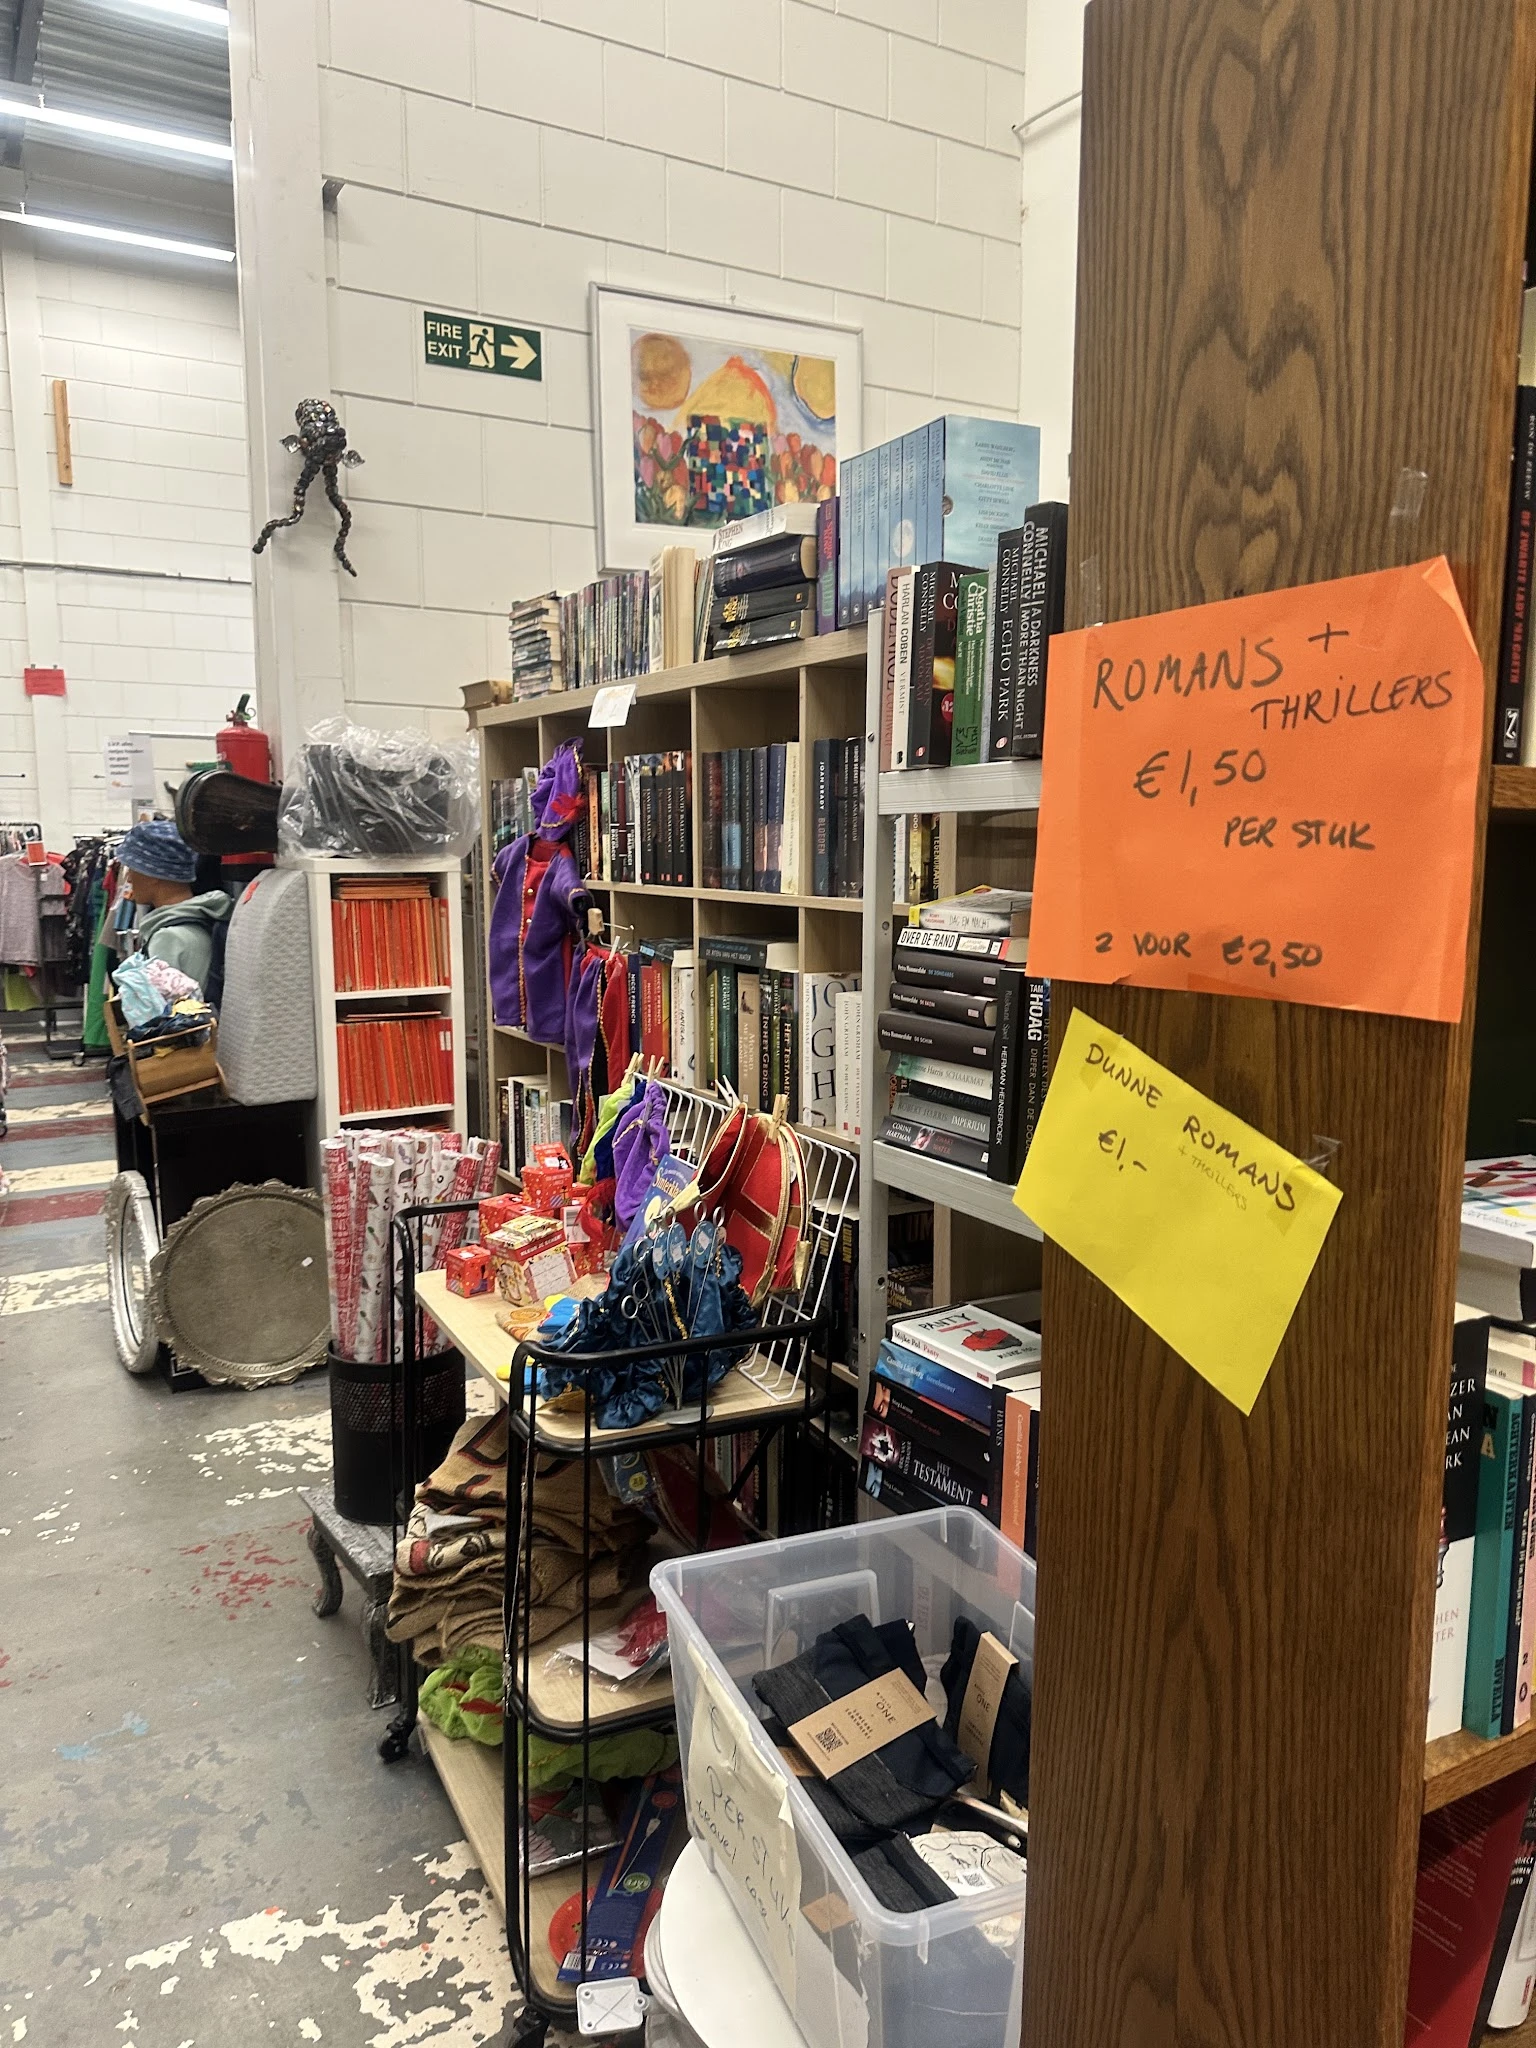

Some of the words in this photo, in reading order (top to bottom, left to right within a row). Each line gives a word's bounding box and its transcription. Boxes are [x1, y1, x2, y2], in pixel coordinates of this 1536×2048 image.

[426, 321, 463, 340] FIRE
[427, 341, 463, 359] EXIT
[1528, 413, 1536, 437] RON
[1527, 442, 1535, 457] DE
[1523, 460, 1533, 500] ZEEUW
[718, 523, 743, 540] STEPHEN
[1011, 547, 1019, 604] MICHAEL
[1019, 520, 1034, 599] CONNELLY
[1032, 527, 1048, 600] MICHAEL
[927, 571, 936, 624] MICHAEL
[1000, 549, 1011, 614] CONNELLY
[900, 583, 911, 625] HARLAN
[919, 572, 929, 633] CONNELLY
[964, 581, 978, 637] Christie
[975, 585, 987, 634] Agatha
[1514, 586, 1525, 618] LADY
[899, 628, 910, 664] COBEN
[1001, 619, 1013, 672] ECHO
[1018, 609, 1029, 647] MORE
[1017, 649, 1028, 686] THAN
[1027, 620, 1041, 686] DARKNESS
[1092, 636, 1284, 712] ROMANS
[1308, 622, 1349, 653] +
[897, 671, 906, 716] VERMIST
[997, 678, 1011, 721] PARK
[1014, 687, 1025, 730] NIGHT
[1133, 749, 1267, 807] €1,50
[817, 817, 826, 855] BLOEDEN
[1223, 816, 1274, 849] PER
[1296, 820, 1376, 851] STUK
[900, 930, 920, 945] OVER
[920, 932, 933, 947] DE
[934, 934, 956, 948] RAND
[1095, 932, 1113, 954] 2
[1132, 932, 1191, 959] VOOR
[1221, 935, 1324, 978] €2,50
[762, 1014, 770, 1029] IN
[783, 1022, 792, 1046] HET
[1001, 1023, 1011, 1040] Spel
[1027, 994, 1044, 1042] HOAG
[1043, 1017, 1050, 1030] DE
[748, 1033, 756, 1070] MOORD
[762, 1030, 770, 1051] HET
[1041, 1031, 1049, 1079] ENGELEN
[762, 1053, 770, 1097] GEDING
[927, 1065, 944, 1077] Harris
[945, 1069, 985, 1087] SCHAAKMAT
[999, 1045, 1008, 1086] HERMAN
[1029, 1047, 1039, 1079] DIEPER
[926, 1087, 955, 1100] PAULA
[1027, 1082, 1036, 1104] DAN
[891, 1121, 913, 1134] CORINE
[897, 1102, 921, 1116] ROBERT
[951, 1115, 987, 1133] IMPERIUM
[995, 1086, 1006, 1145] HEINSBROEK
[1026, 1107, 1035, 1121] DE
[1084, 1042, 1164, 1109] DUNNE
[1182, 1114, 1297, 1212] ROMANS
[885, 1129, 912, 1143] HARTMAN
[917, 1312, 973, 1331] PANTY
[894, 1329, 911, 1345] Mijke
[911, 1337, 921, 1349] Pol
[922, 1344, 941, 1360] Panty
[886, 1355, 904, 1369] Camilla
[902, 1363, 924, 1380] Läckberg
[1488, 1367, 1497, 1376] uit
[1498, 1368, 1507, 1378] de
[996, 1409, 1005, 1447] HAYNES
[912, 1459, 974, 1506] TESTAMENT
[936, 1461, 952, 1477] HET
[1504, 1411, 1521, 1531] ACHTERKANTEN
[1519, 1528, 1528, 1548] doe
[976, 1694, 991, 1713] ONE
[1490, 1656, 1506, 1724] NOVELLA
[875, 1701, 897, 1725] ONE
[706, 1763, 745, 1840] PER
